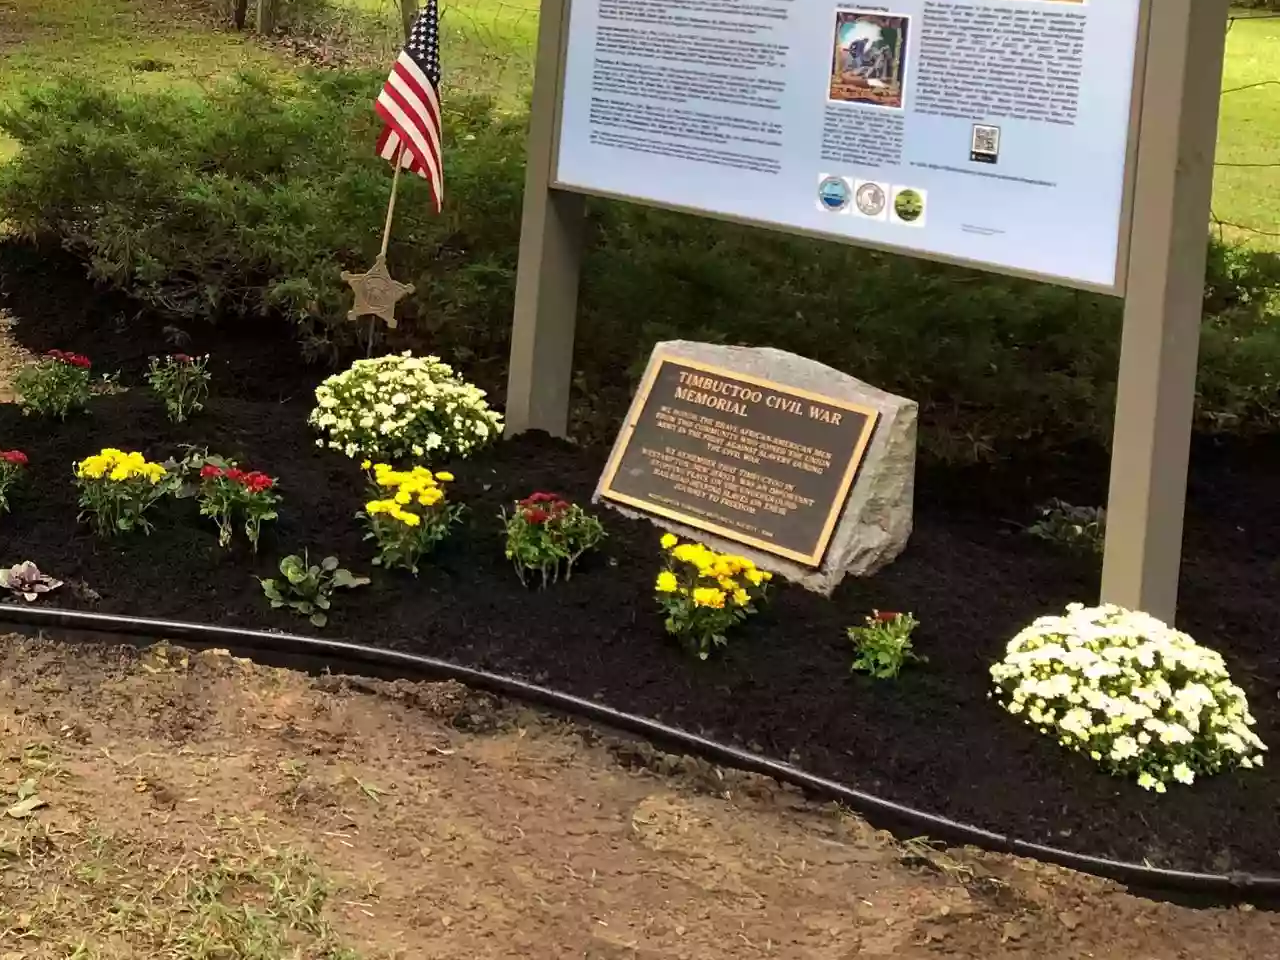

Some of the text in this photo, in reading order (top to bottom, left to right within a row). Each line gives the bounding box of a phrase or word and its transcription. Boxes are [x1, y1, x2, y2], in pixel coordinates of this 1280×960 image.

[674, 386, 748, 417] MEMORIAL
[679, 371, 842, 426] TIMBUCTOO CIVIL WAR
